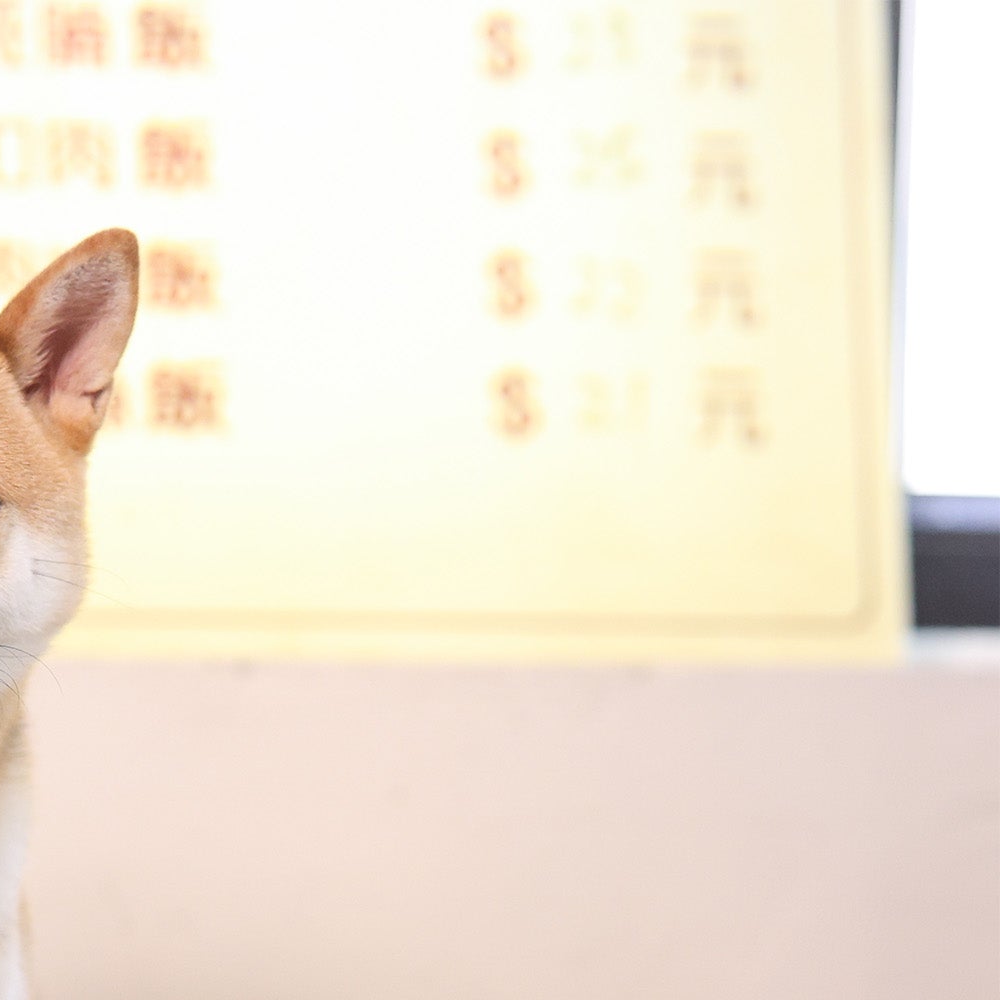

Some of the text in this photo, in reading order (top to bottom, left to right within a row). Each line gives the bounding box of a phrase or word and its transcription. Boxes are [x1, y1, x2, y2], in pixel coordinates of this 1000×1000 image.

[478, 9, 531, 83] $
[680, 11, 760, 94] 元
[482, 125, 534, 203] $
[685, 129, 764, 213] 元
[484, 247, 539, 324] $
[690, 247, 769, 334] 元
[489, 364, 546, 442] $
[692, 365, 772, 449] 元
